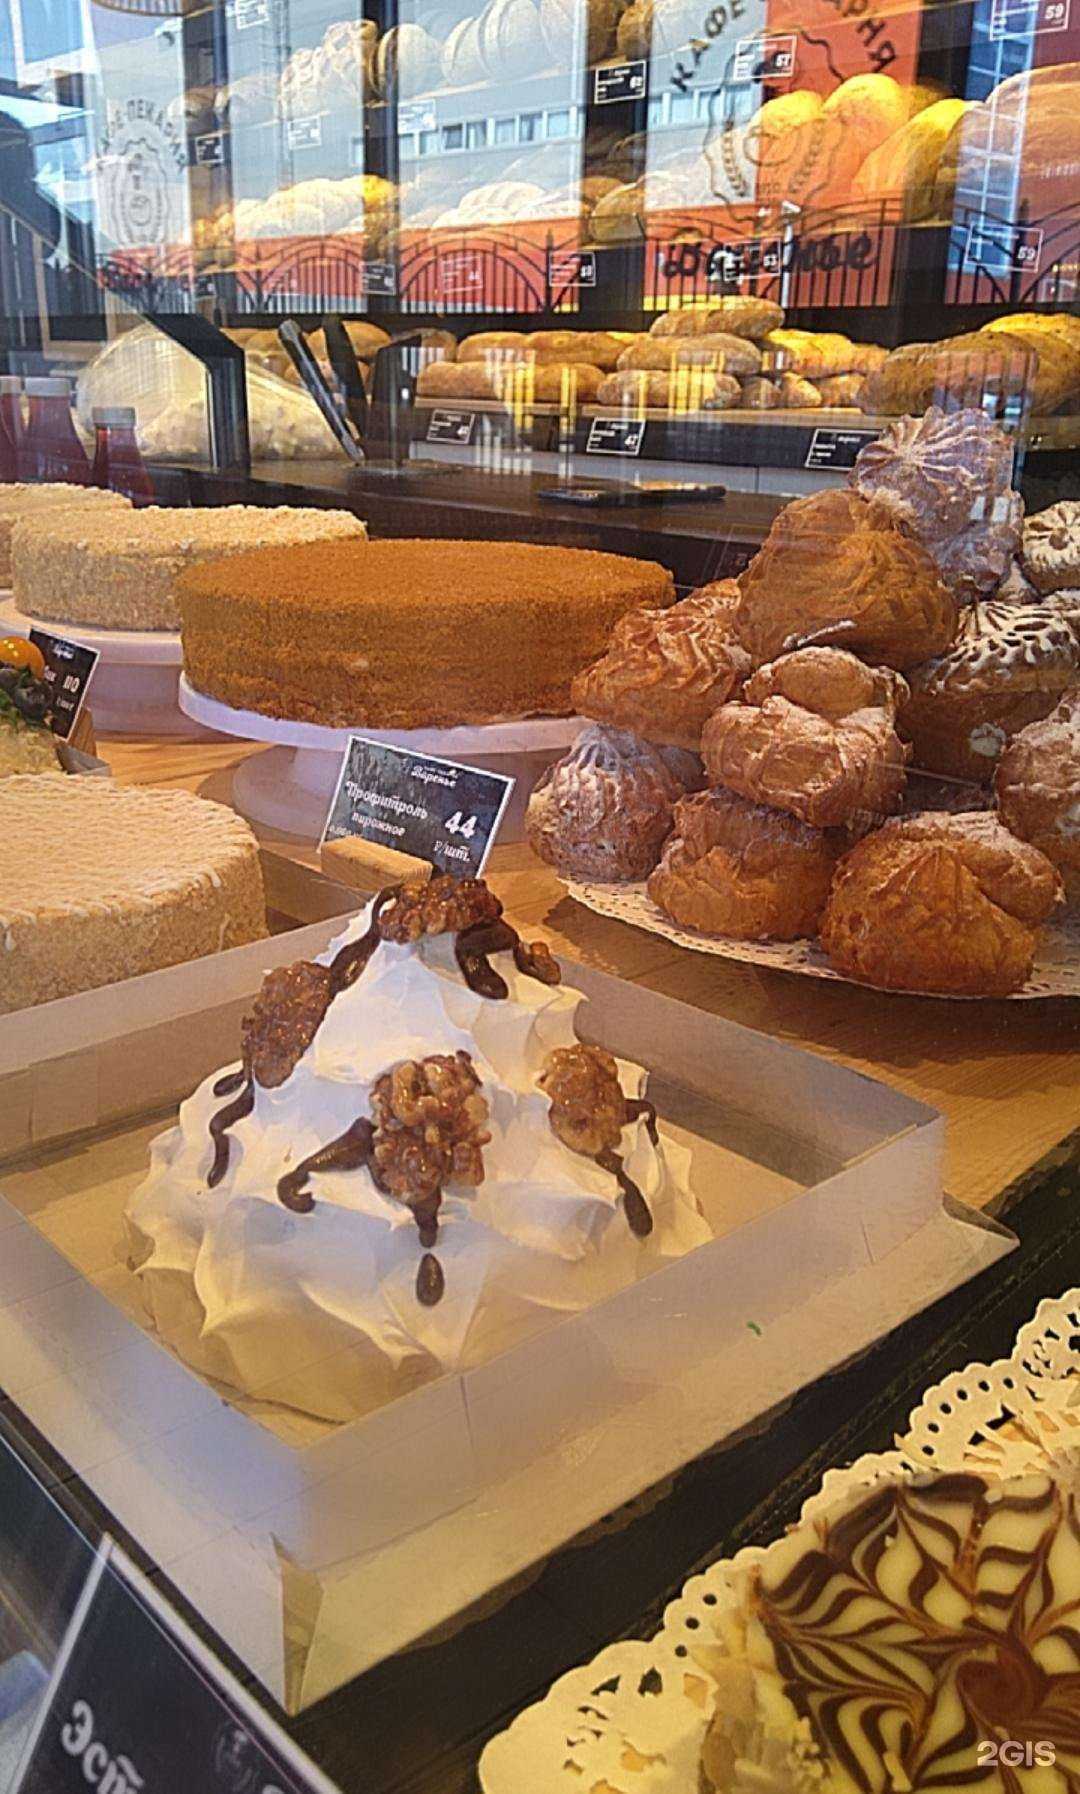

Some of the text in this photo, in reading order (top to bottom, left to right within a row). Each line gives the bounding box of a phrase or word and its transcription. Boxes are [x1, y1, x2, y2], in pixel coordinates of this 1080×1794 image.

[346, 780, 429, 820] Профитроль
[351, 812, 407, 837] пирожное
[444, 811, 477, 839] 44
